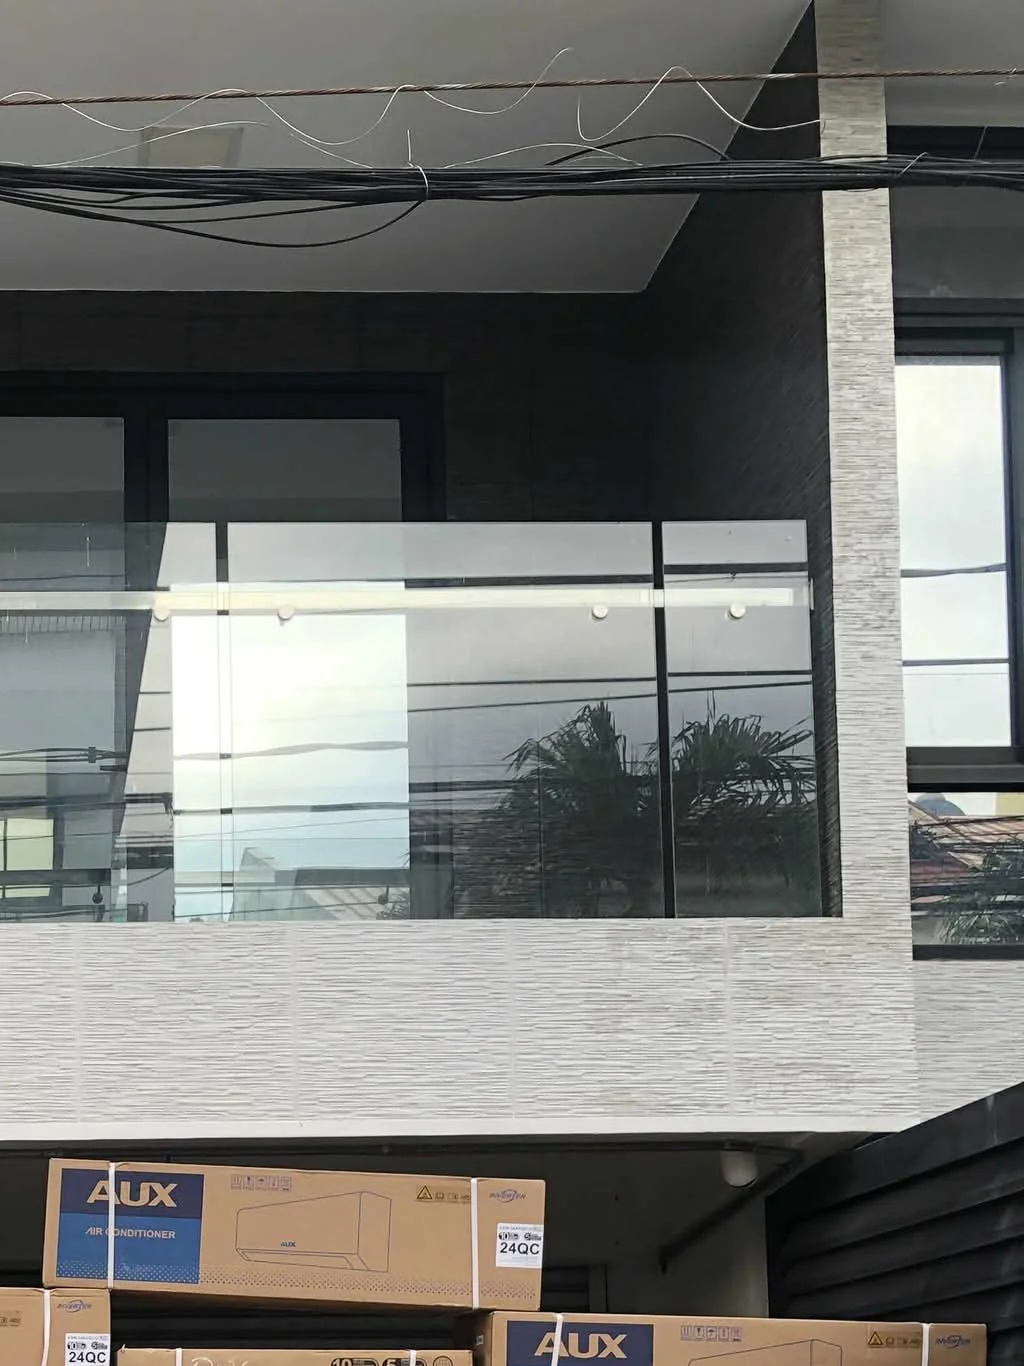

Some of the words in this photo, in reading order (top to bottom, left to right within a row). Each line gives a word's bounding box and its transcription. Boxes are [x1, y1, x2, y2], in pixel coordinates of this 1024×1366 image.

[86, 1180, 178, 1207] AUX
[85, 1226, 102, 1236] AIR
[500, 1241, 540, 1255] 24QC
[534, 1331, 627, 1359] AUX
[69, 1351, 106, 1364] 24QC
